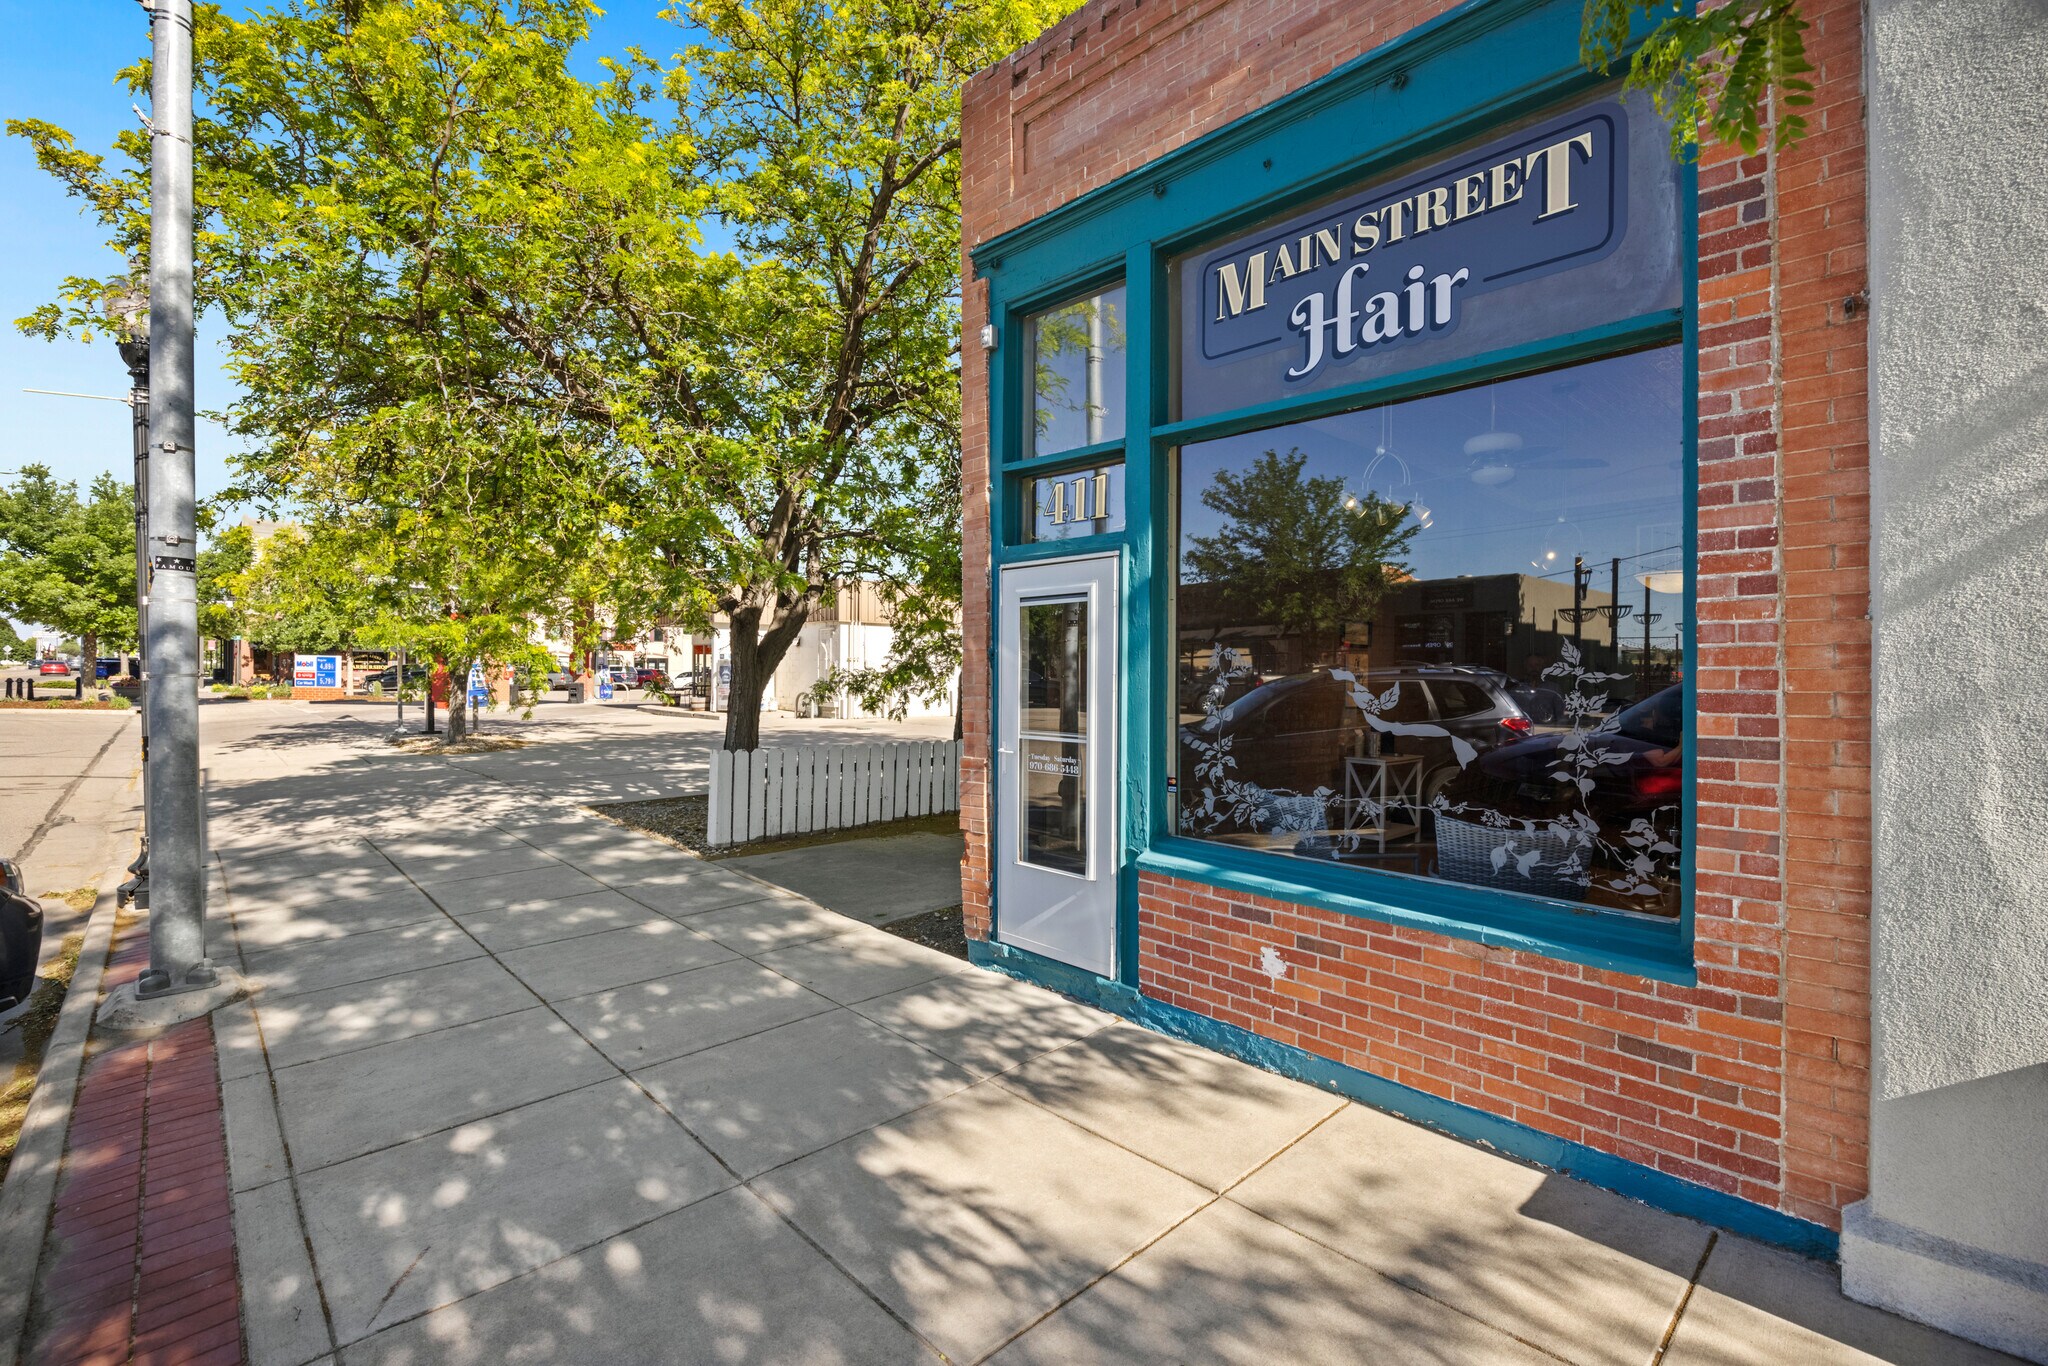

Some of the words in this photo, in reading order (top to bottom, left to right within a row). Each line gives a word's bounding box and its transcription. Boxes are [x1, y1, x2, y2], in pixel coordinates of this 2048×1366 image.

[1215, 223, 1343, 322] MAIN
[1353, 131, 1594, 256] STREET
[1287, 262, 1470, 377] Hair
[1044, 473, 1109, 526] 411
[155, 563, 195, 571] FAMOUS
